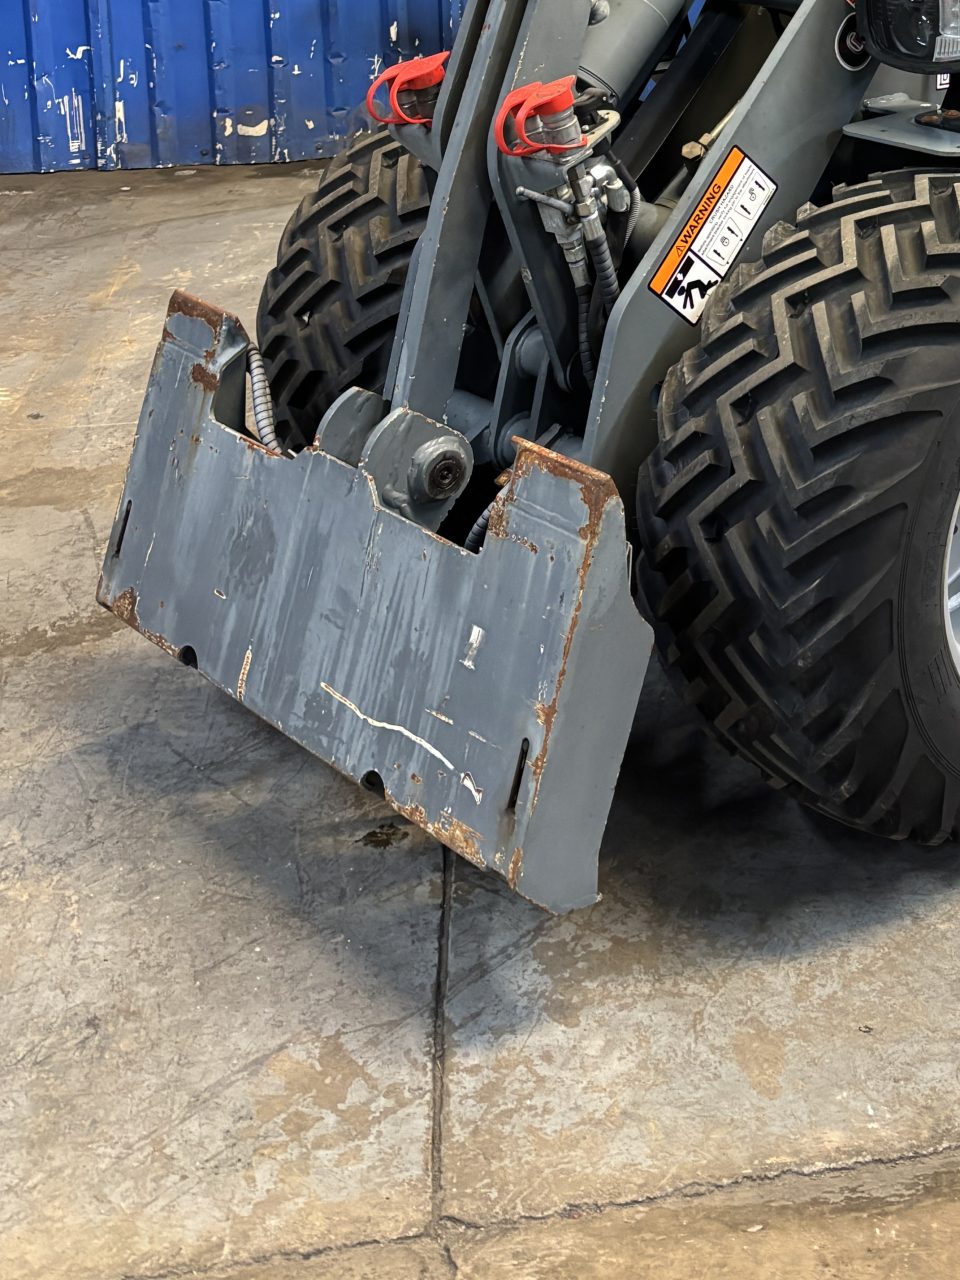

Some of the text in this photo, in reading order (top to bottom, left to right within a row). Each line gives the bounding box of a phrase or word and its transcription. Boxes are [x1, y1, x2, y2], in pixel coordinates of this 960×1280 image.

[680, 183, 722, 245] WARNING
[708, 183, 734, 224] CRUSH HAZARD
